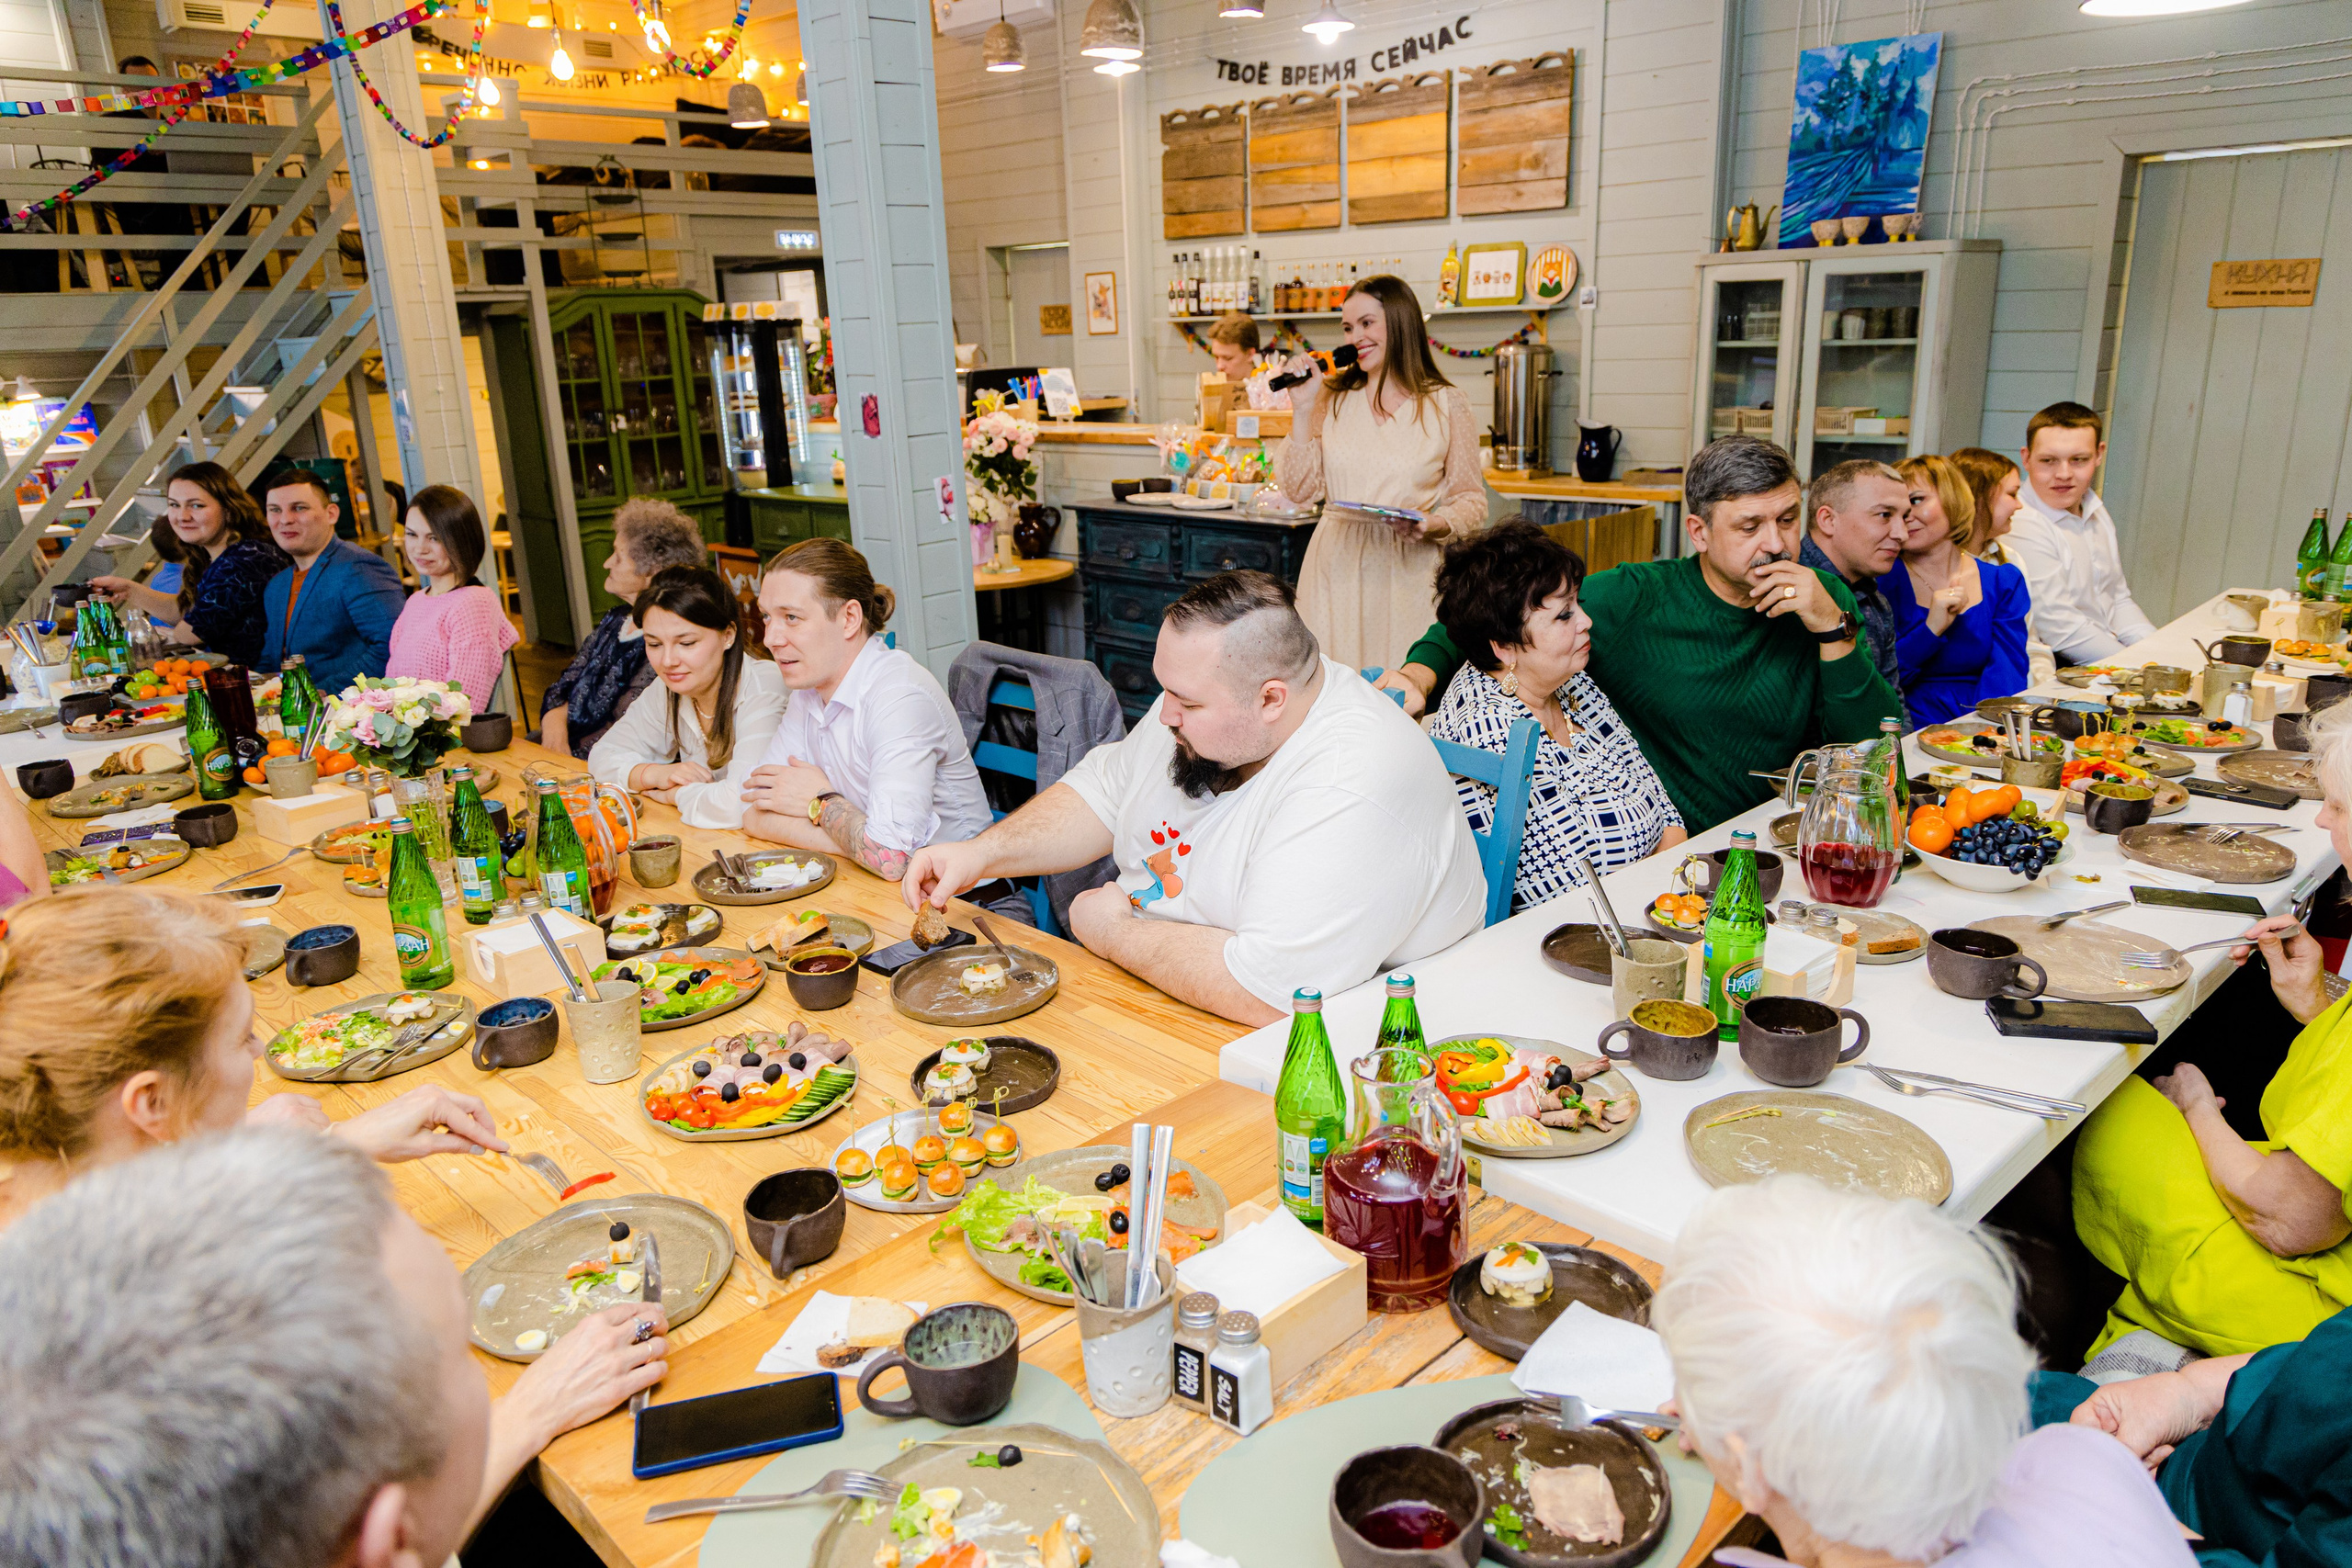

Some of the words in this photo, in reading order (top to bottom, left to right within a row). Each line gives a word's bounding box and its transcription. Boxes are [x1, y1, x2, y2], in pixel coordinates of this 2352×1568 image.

[1217, 59, 1269, 85] ТВОЁ
[1282, 58, 1356, 85] ВРЕМЯ
[1371, 16, 1473, 73] СЕЙЧАС
[1178, 1349, 1200, 1396] PEPPER
[1216, 1374, 1233, 1418] SALT
